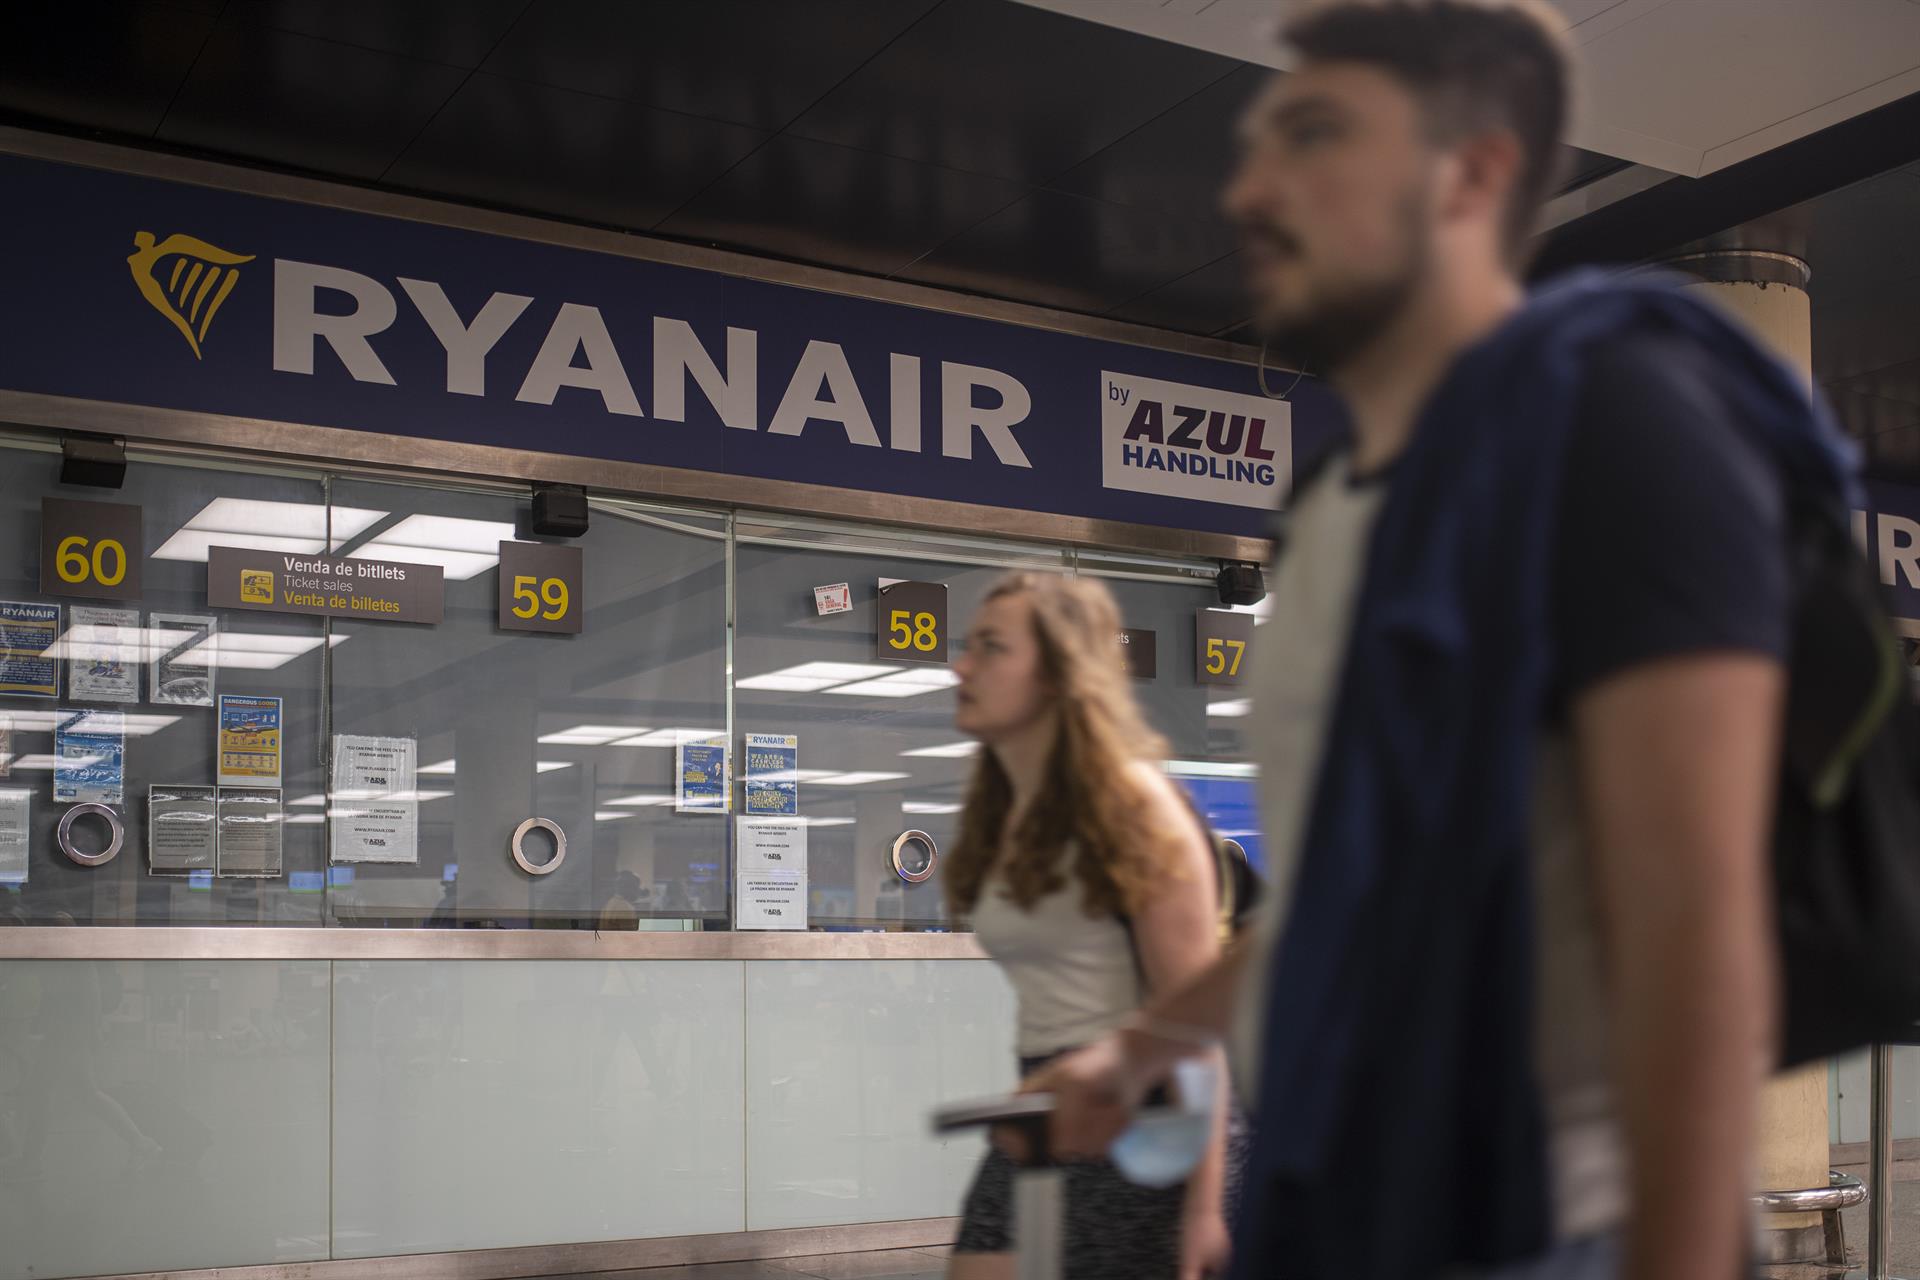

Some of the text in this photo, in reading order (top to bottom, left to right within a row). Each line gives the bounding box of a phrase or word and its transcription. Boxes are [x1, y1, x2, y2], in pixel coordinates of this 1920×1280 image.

[273, 258, 1033, 468] RYANAIR
[1109, 381, 1130, 406] by
[1123, 400, 1275, 461] AZUL
[1122, 444, 1275, 486] HANDLING
[56, 536, 126, 586] 60
[284, 557, 406, 580] Venda de bitllets
[284, 574, 353, 592] Ticket sales
[284, 591, 400, 613] Venta de billetes
[512, 575, 569, 620] 59
[2, 607, 56, 619] RYANAIR
[889, 610, 938, 652] 58
[1206, 638, 1246, 676] 57
[753, 736, 786, 745] RYANAIR
